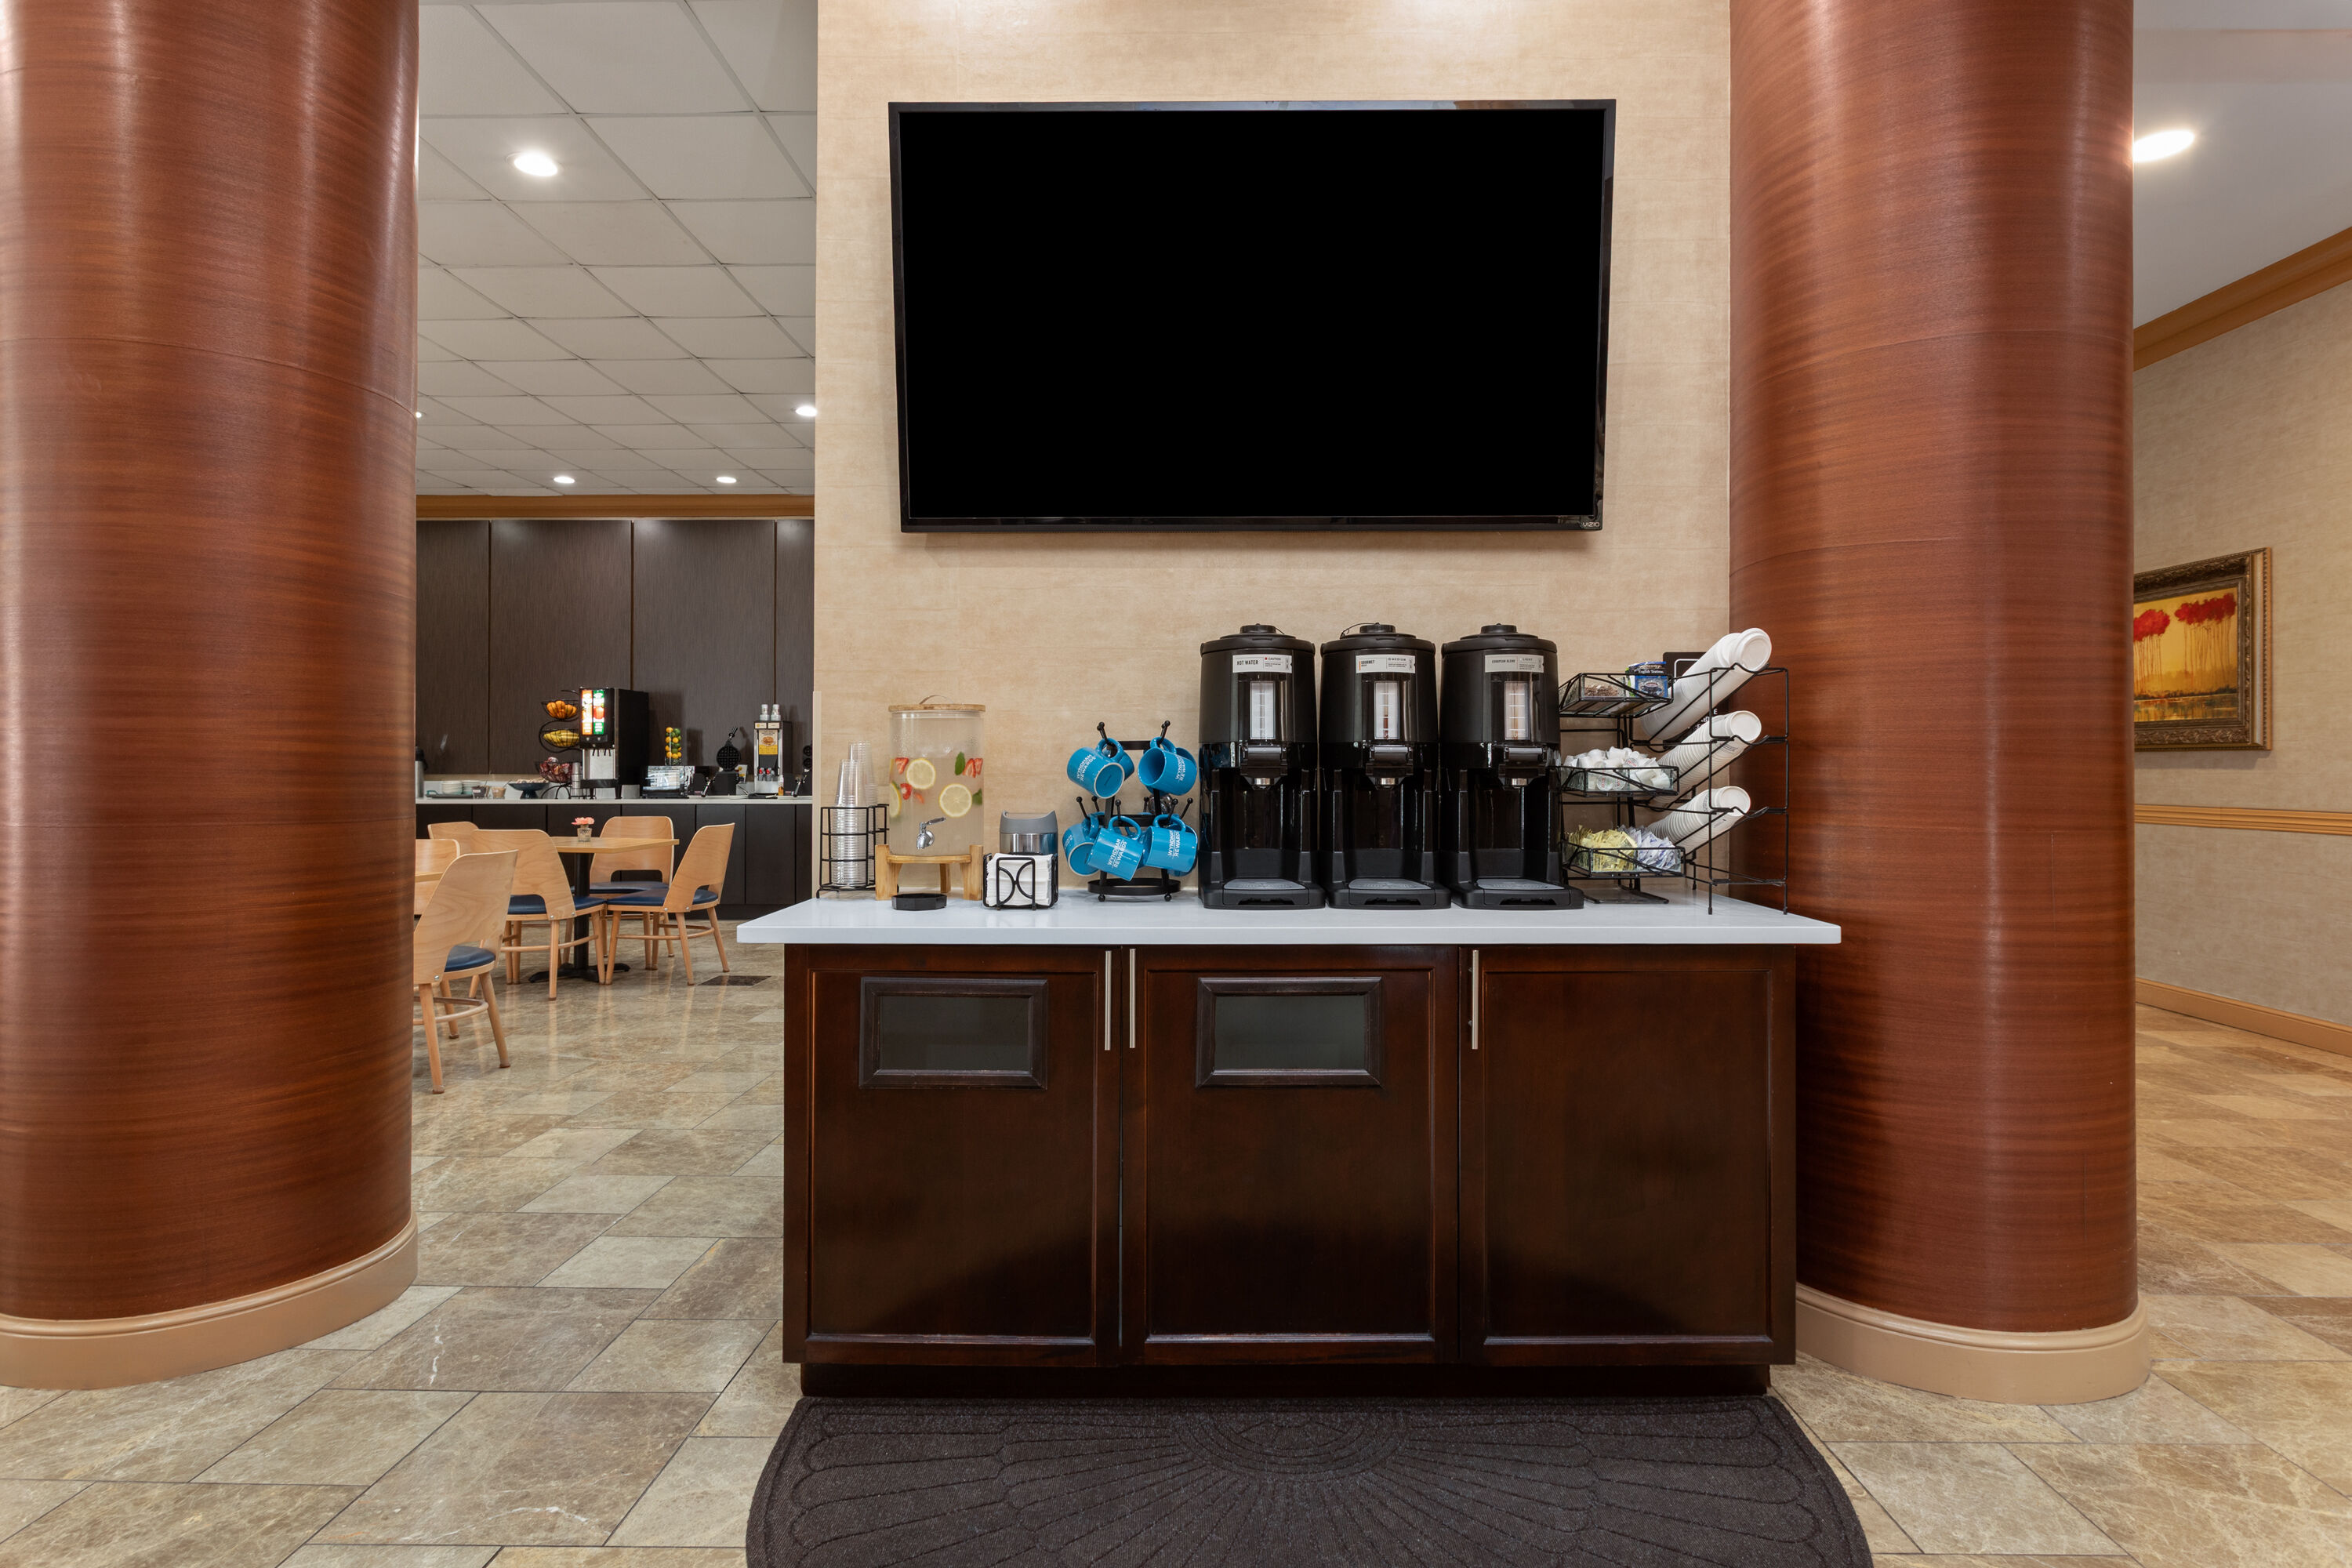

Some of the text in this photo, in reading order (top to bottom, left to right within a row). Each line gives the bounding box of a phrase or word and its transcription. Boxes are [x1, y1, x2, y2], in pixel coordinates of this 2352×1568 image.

[1076, 754, 1092, 779] WYNDHAM
[1080, 756, 1096, 782] REWARDS
[1107, 838, 1121, 866] WYNDHAM
[1113, 840, 1127, 868] REWARDS
